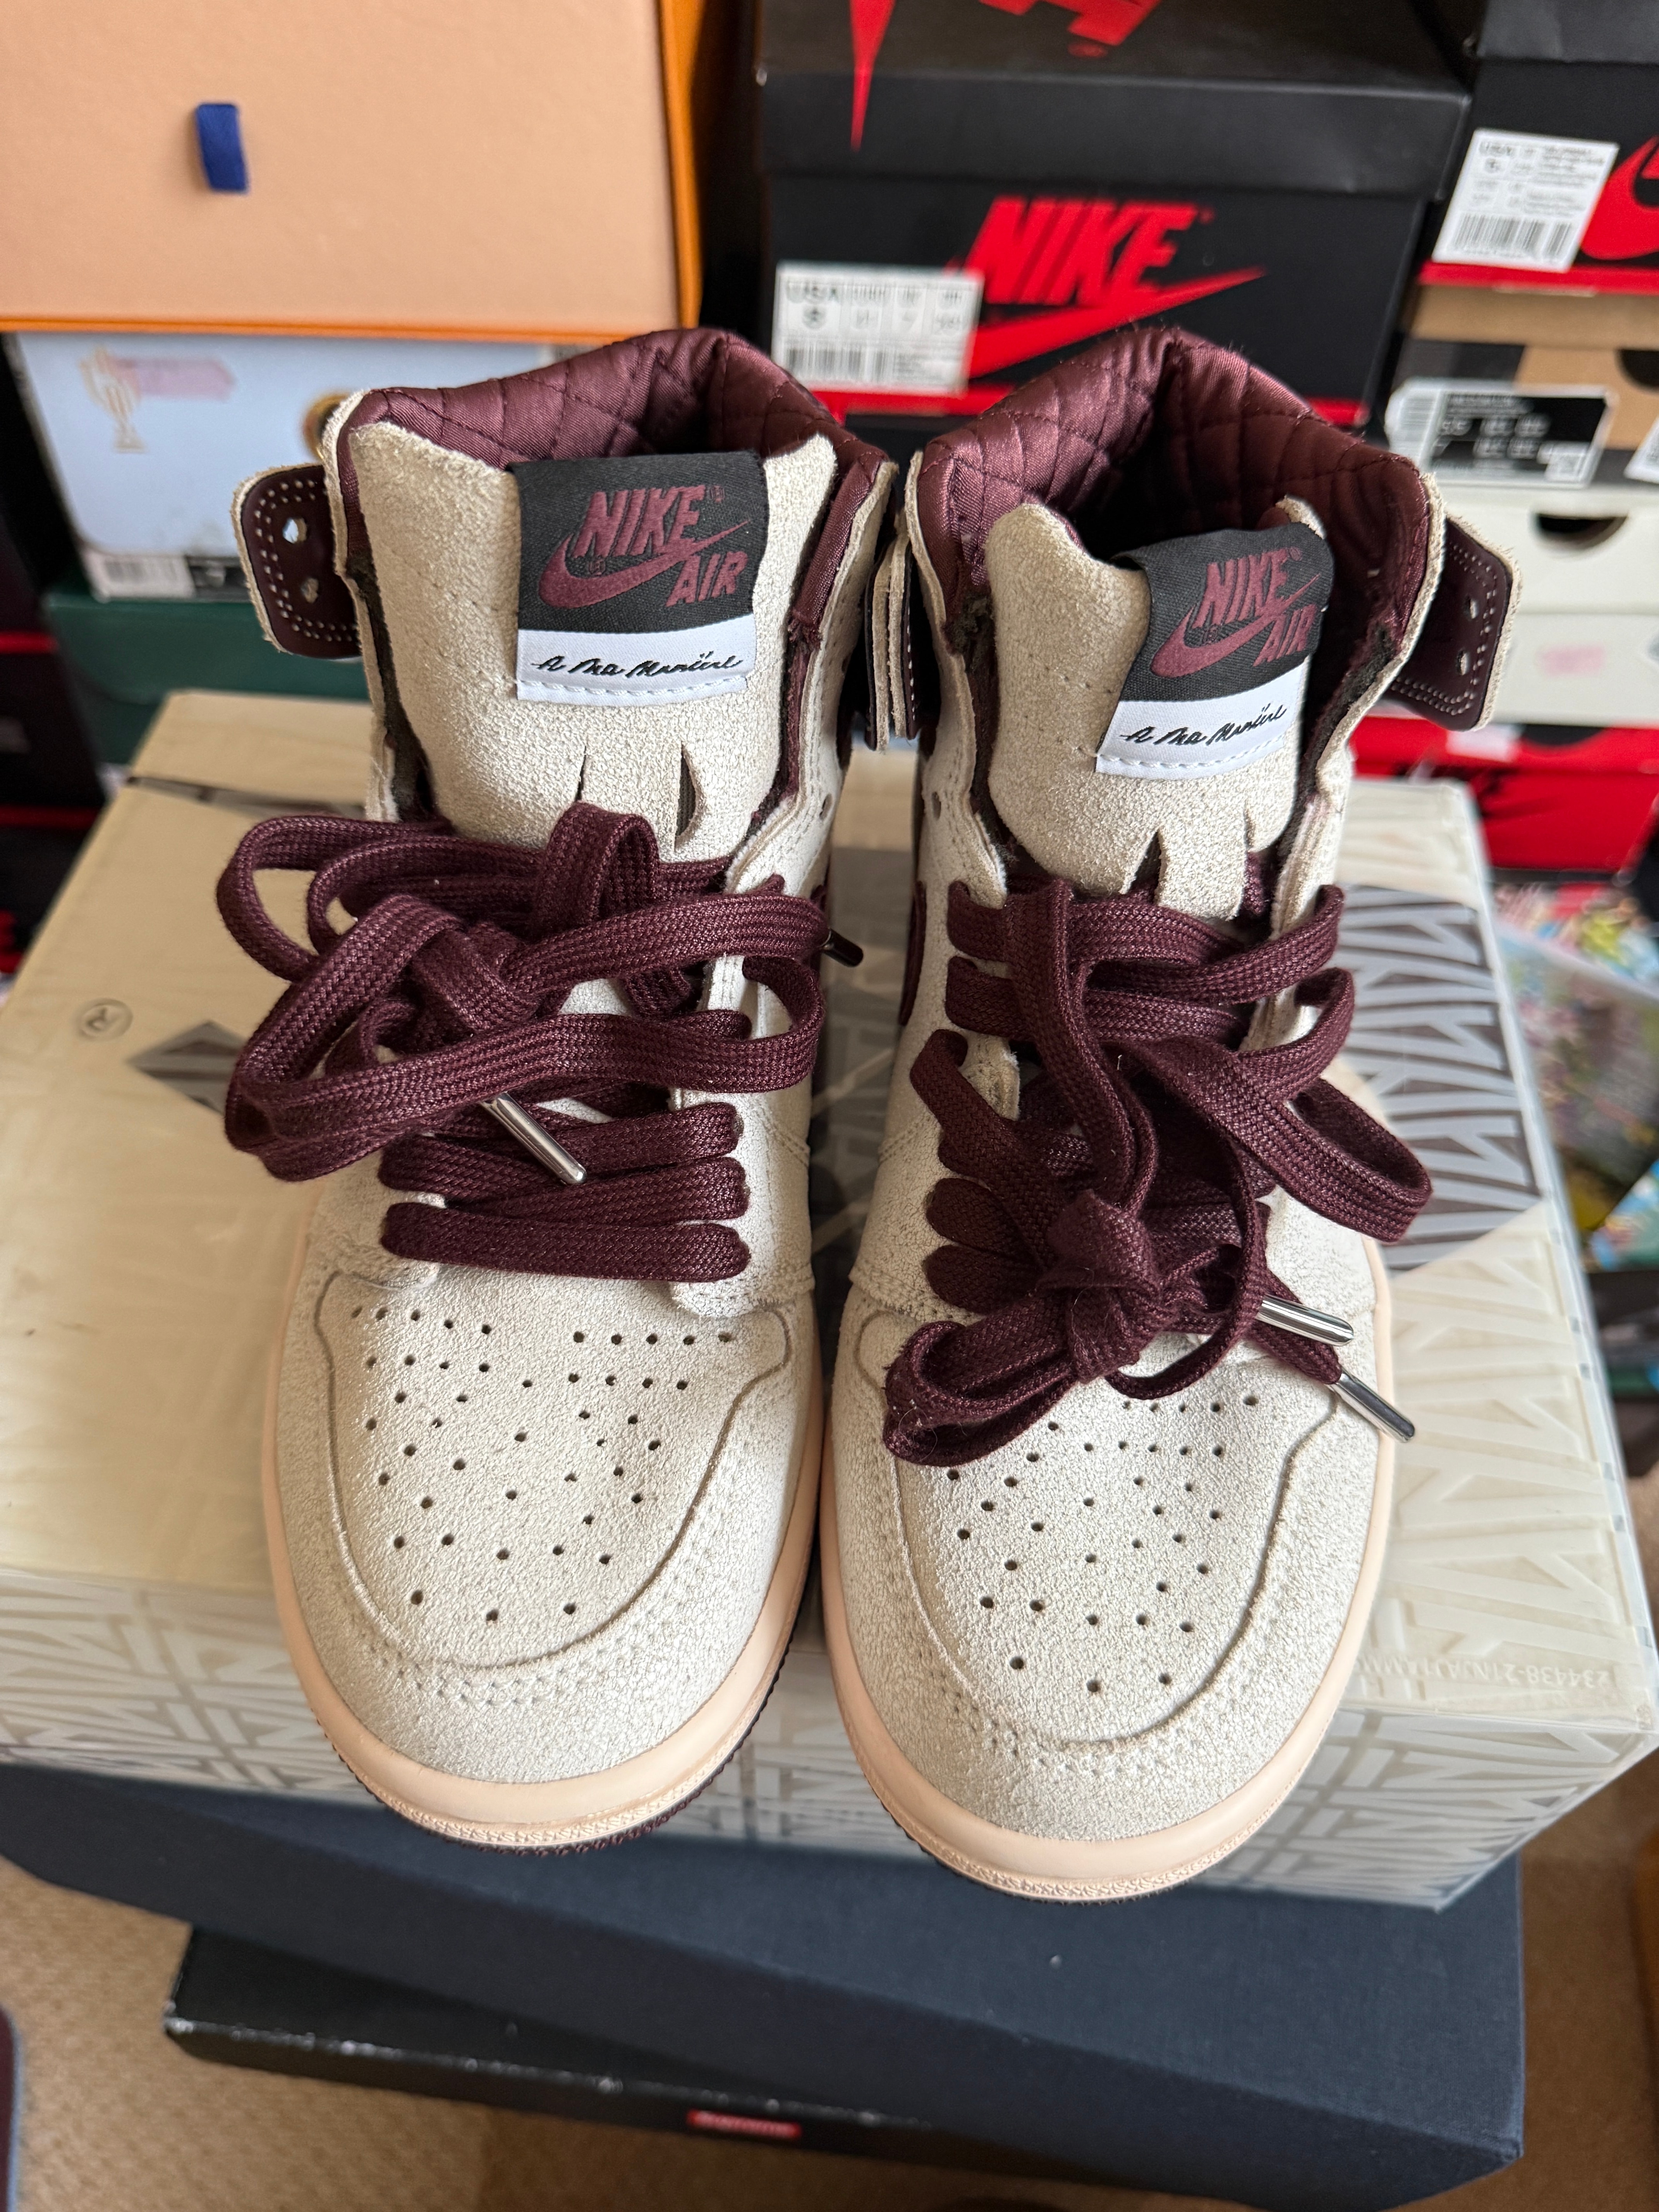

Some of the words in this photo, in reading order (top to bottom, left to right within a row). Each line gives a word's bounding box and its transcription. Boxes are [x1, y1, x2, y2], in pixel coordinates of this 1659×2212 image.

[963, 196, 1198, 306] NIKE
[570, 484, 706, 558] NIKE
[666, 550, 748, 607] AIR
[1192, 548, 1288, 629] NIKE
[1252, 604, 1316, 667] AIR
